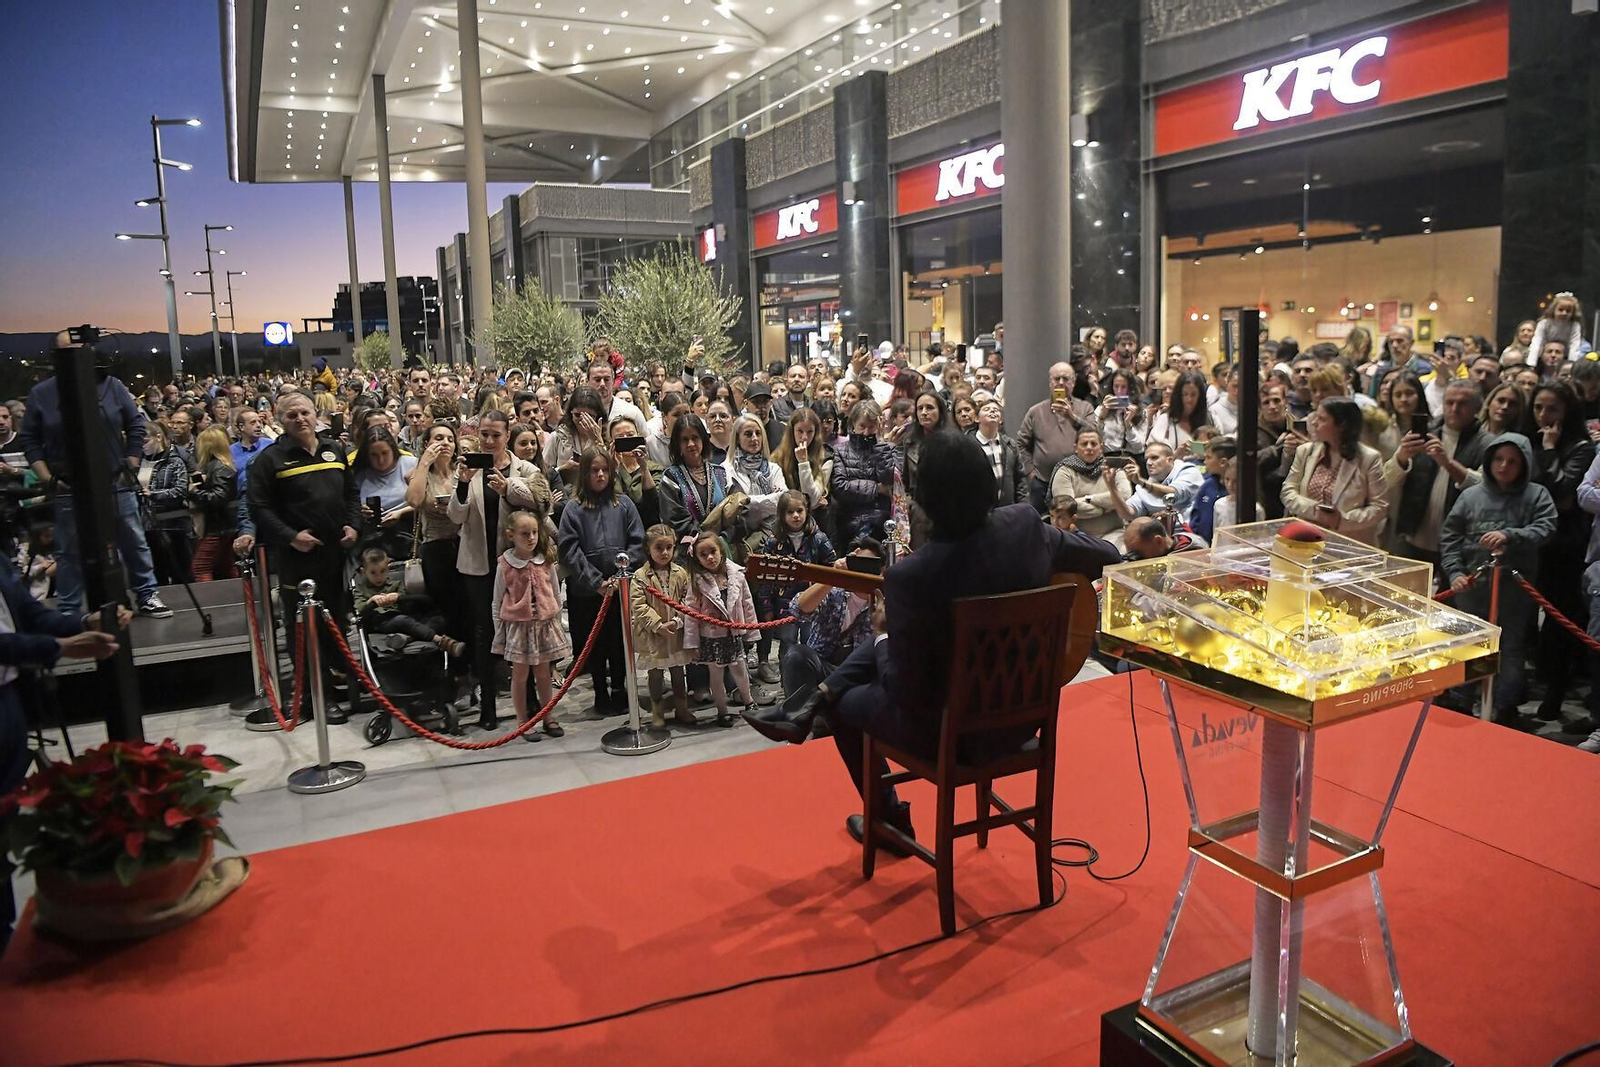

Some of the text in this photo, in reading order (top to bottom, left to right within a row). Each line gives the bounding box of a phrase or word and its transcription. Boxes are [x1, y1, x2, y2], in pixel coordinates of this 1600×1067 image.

[1232, 36, 1388, 130] KFC
[935, 143, 1005, 201] KFC
[776, 199, 819, 240] KFC
